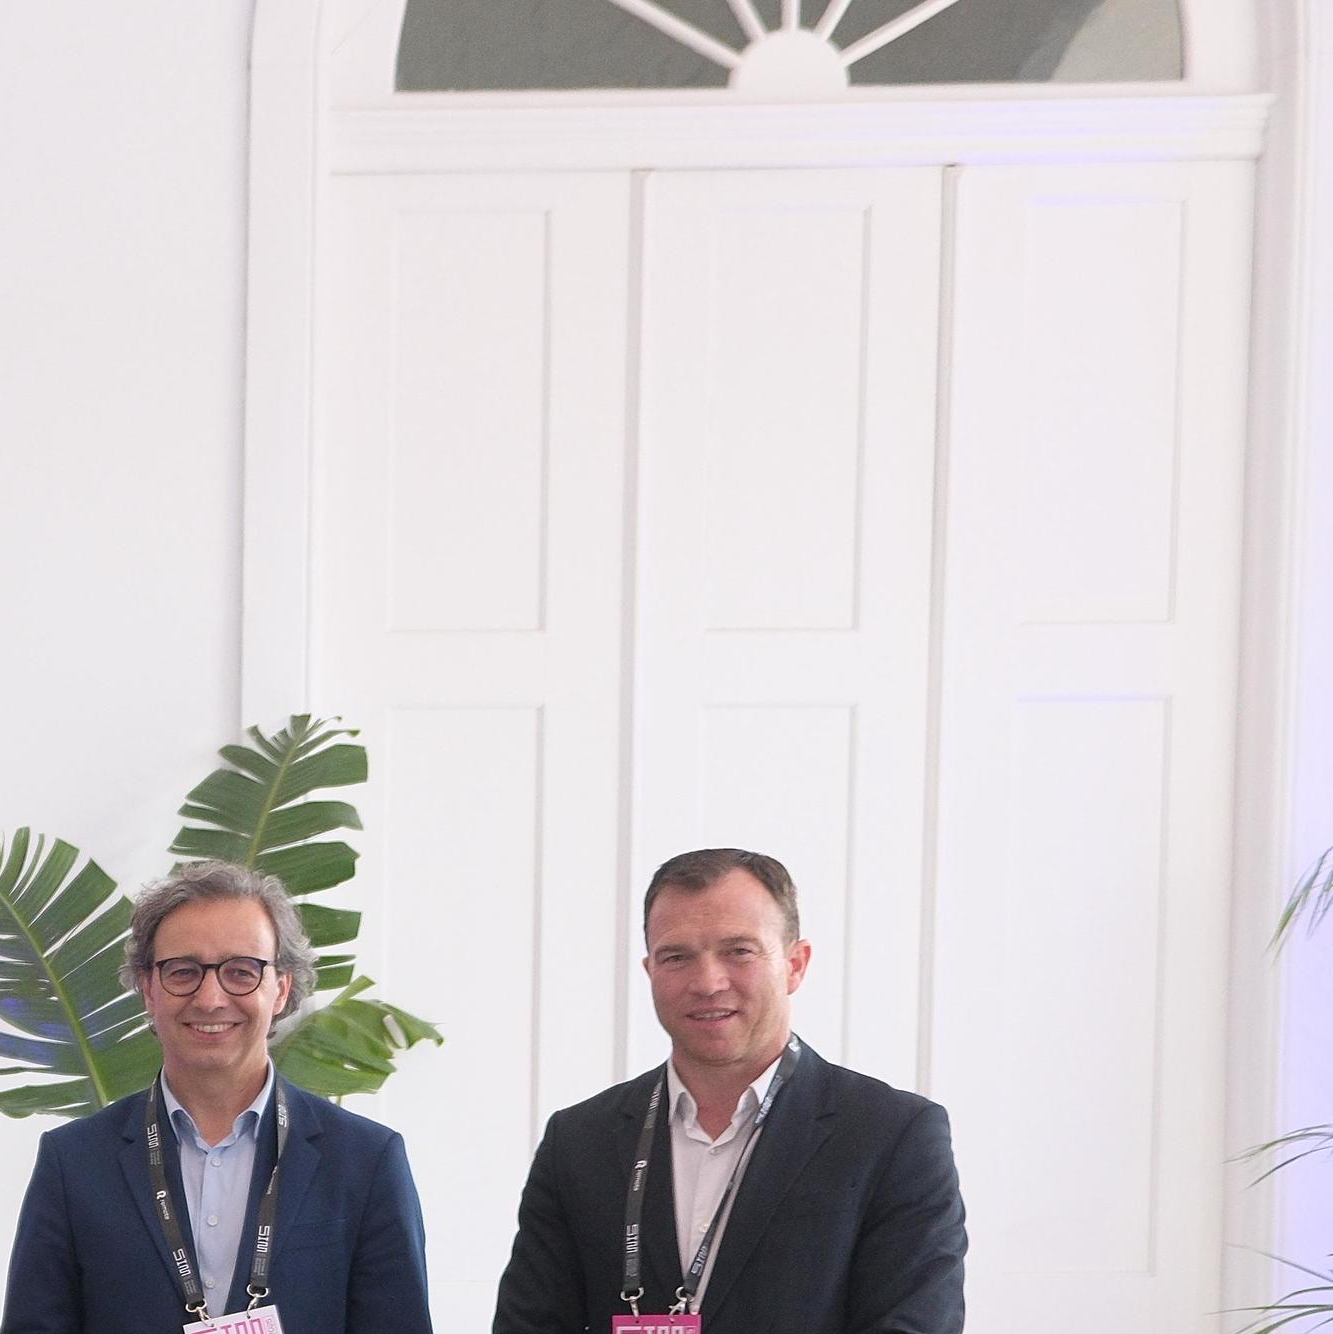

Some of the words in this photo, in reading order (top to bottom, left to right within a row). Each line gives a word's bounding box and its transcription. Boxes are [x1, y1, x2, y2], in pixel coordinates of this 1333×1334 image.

[147, 1123, 158, 1149] SIM
[257, 1225, 270, 1253] SIM
[173, 1248, 191, 1277] SIM
